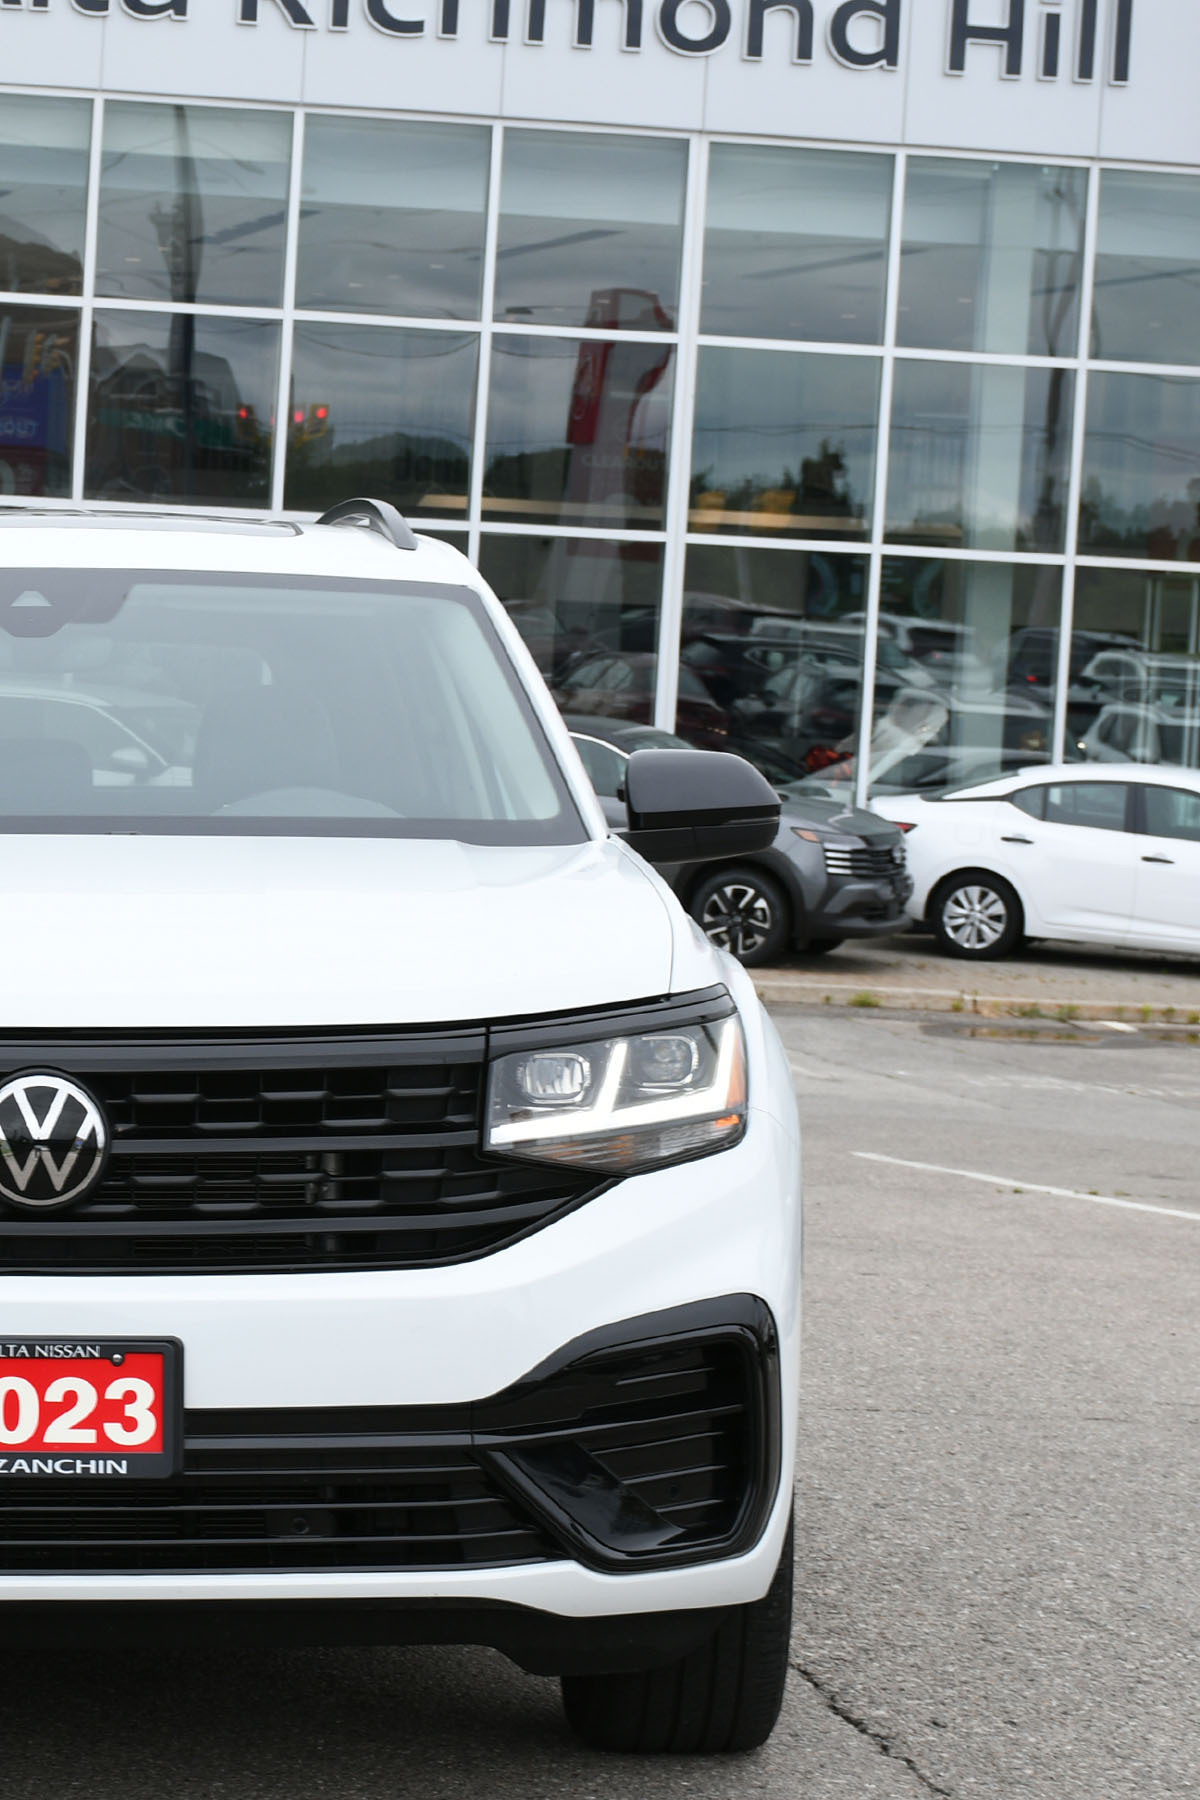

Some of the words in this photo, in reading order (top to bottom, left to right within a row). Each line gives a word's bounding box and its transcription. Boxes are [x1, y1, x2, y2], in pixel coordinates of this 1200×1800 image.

[236, 0, 899, 71] cmond
[944, 0, 1132, 86] Hill
[35, 1345, 101, 1358] NISSAN
